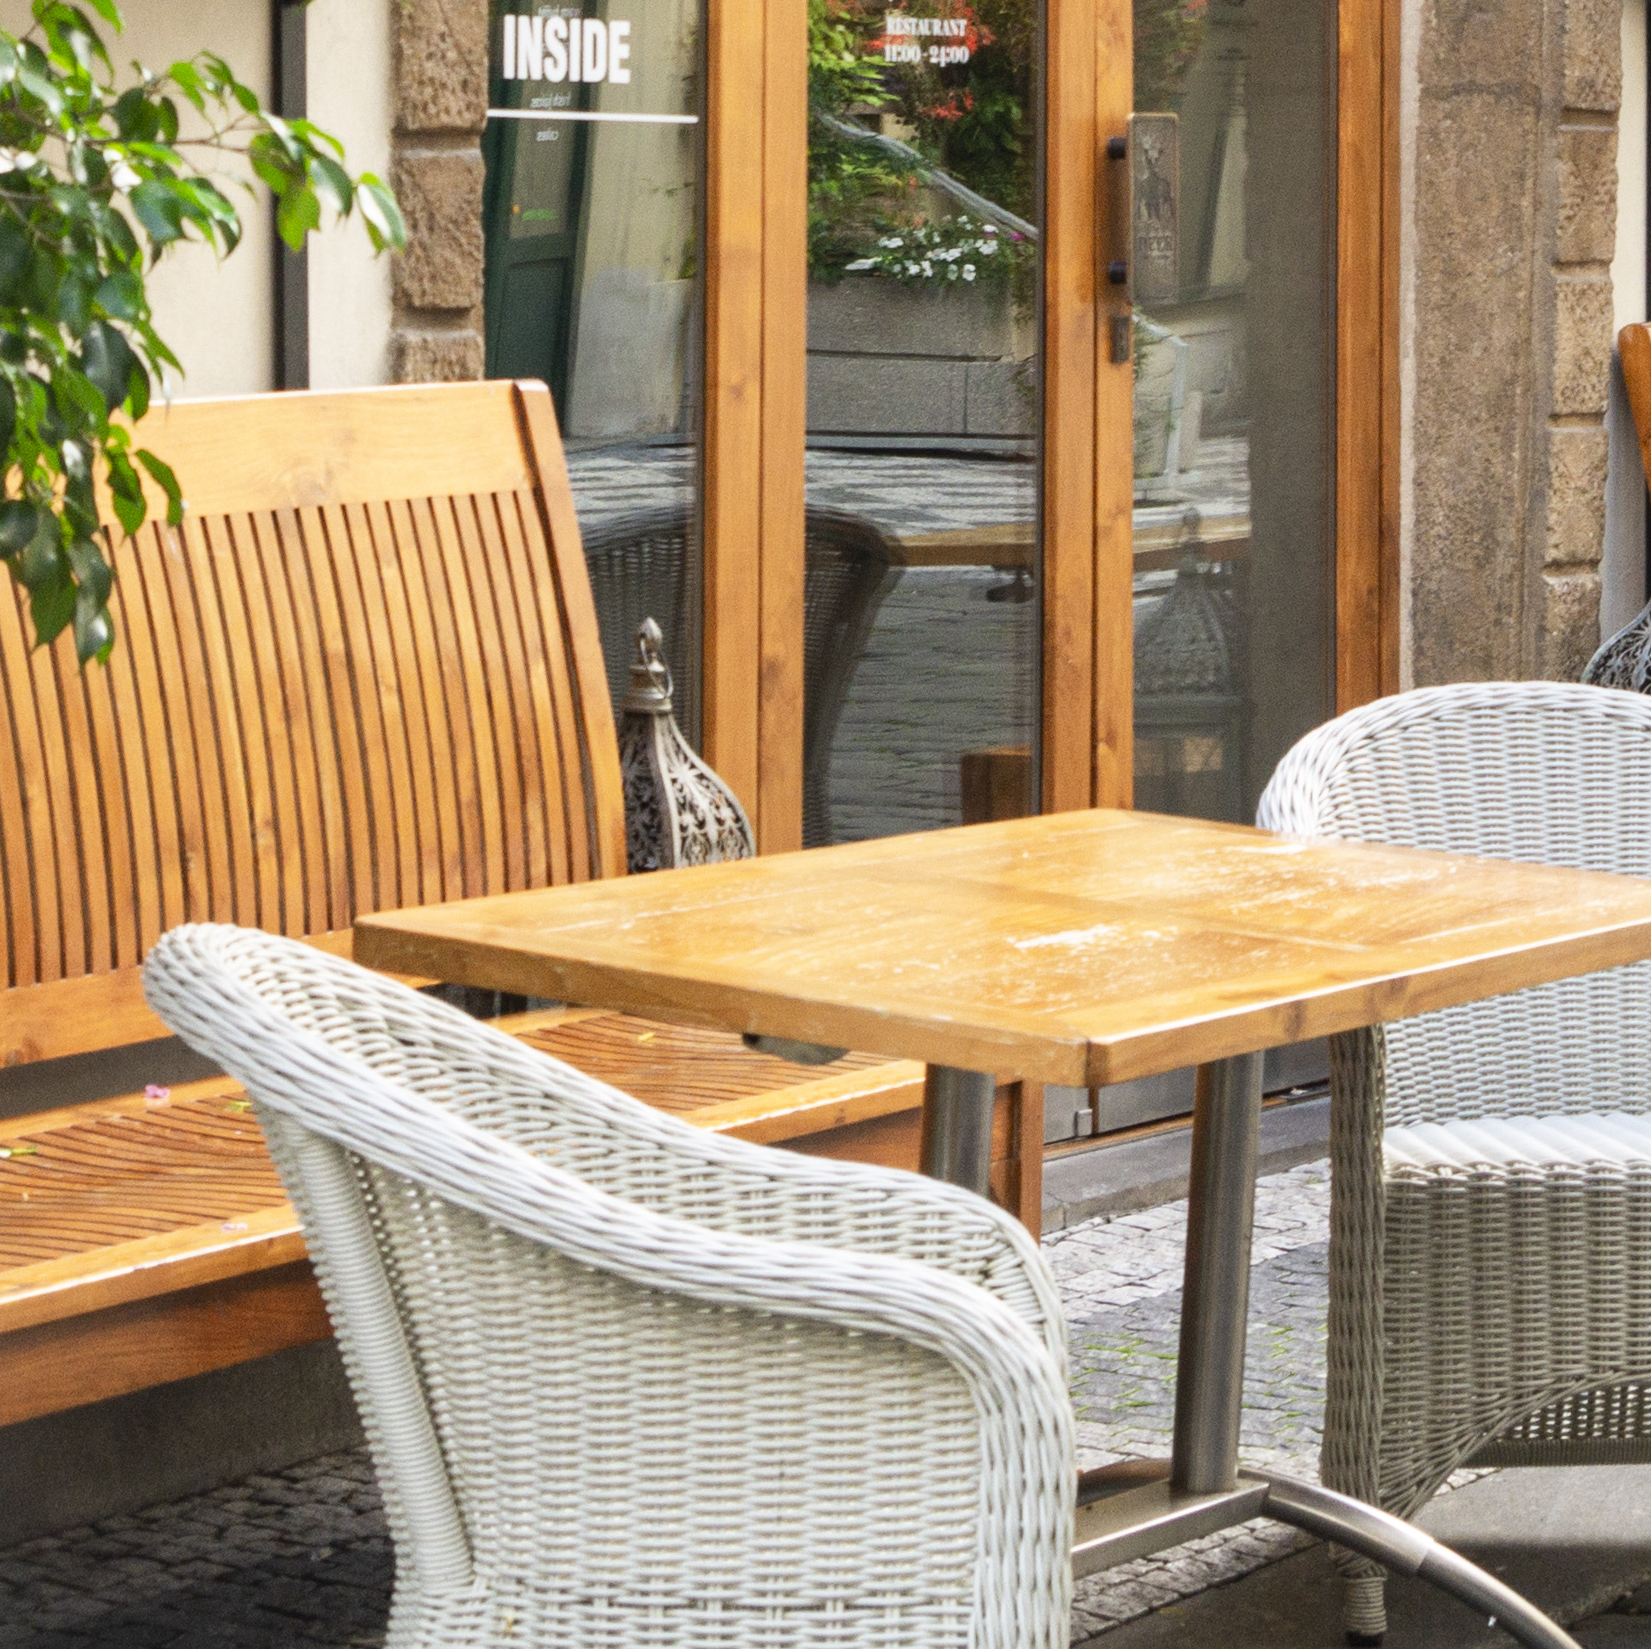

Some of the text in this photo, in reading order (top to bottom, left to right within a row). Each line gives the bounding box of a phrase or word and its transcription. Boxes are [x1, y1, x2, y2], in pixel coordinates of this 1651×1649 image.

[886, 17, 968, 37] RESTAURANT
[503, 14, 631, 85] INSIDE
[884, 44, 922, 63] 11:00
[929, 45, 970, 68] 24:00
